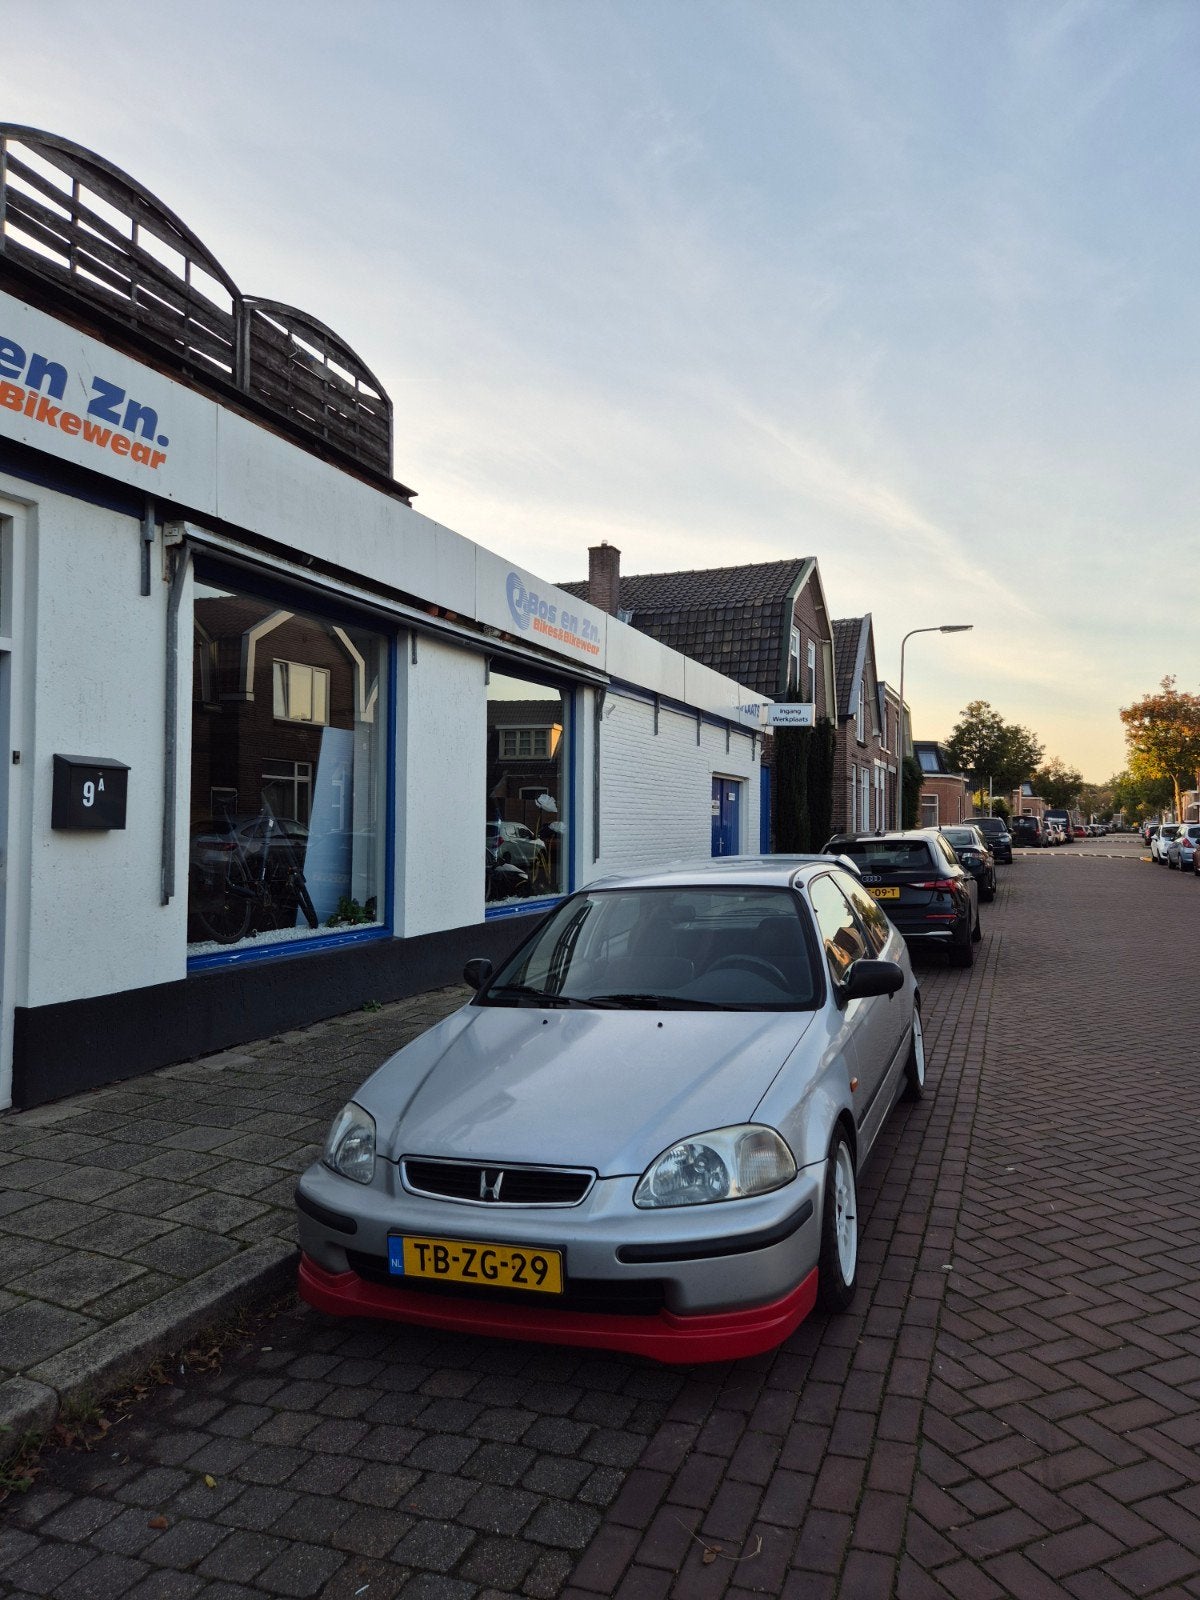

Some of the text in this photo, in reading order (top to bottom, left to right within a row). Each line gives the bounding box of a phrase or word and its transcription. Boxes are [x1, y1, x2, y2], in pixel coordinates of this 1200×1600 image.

[0, 336, 169, 447] en Zn.
[0, 380, 167, 469] Bikewear
[528, 592, 557, 624] Bos
[561, 610, 578, 634] en
[533, 617, 600, 655] Bikes&Bikewear
[391, 1243, 548, 1285] NL TB-ZG-29
